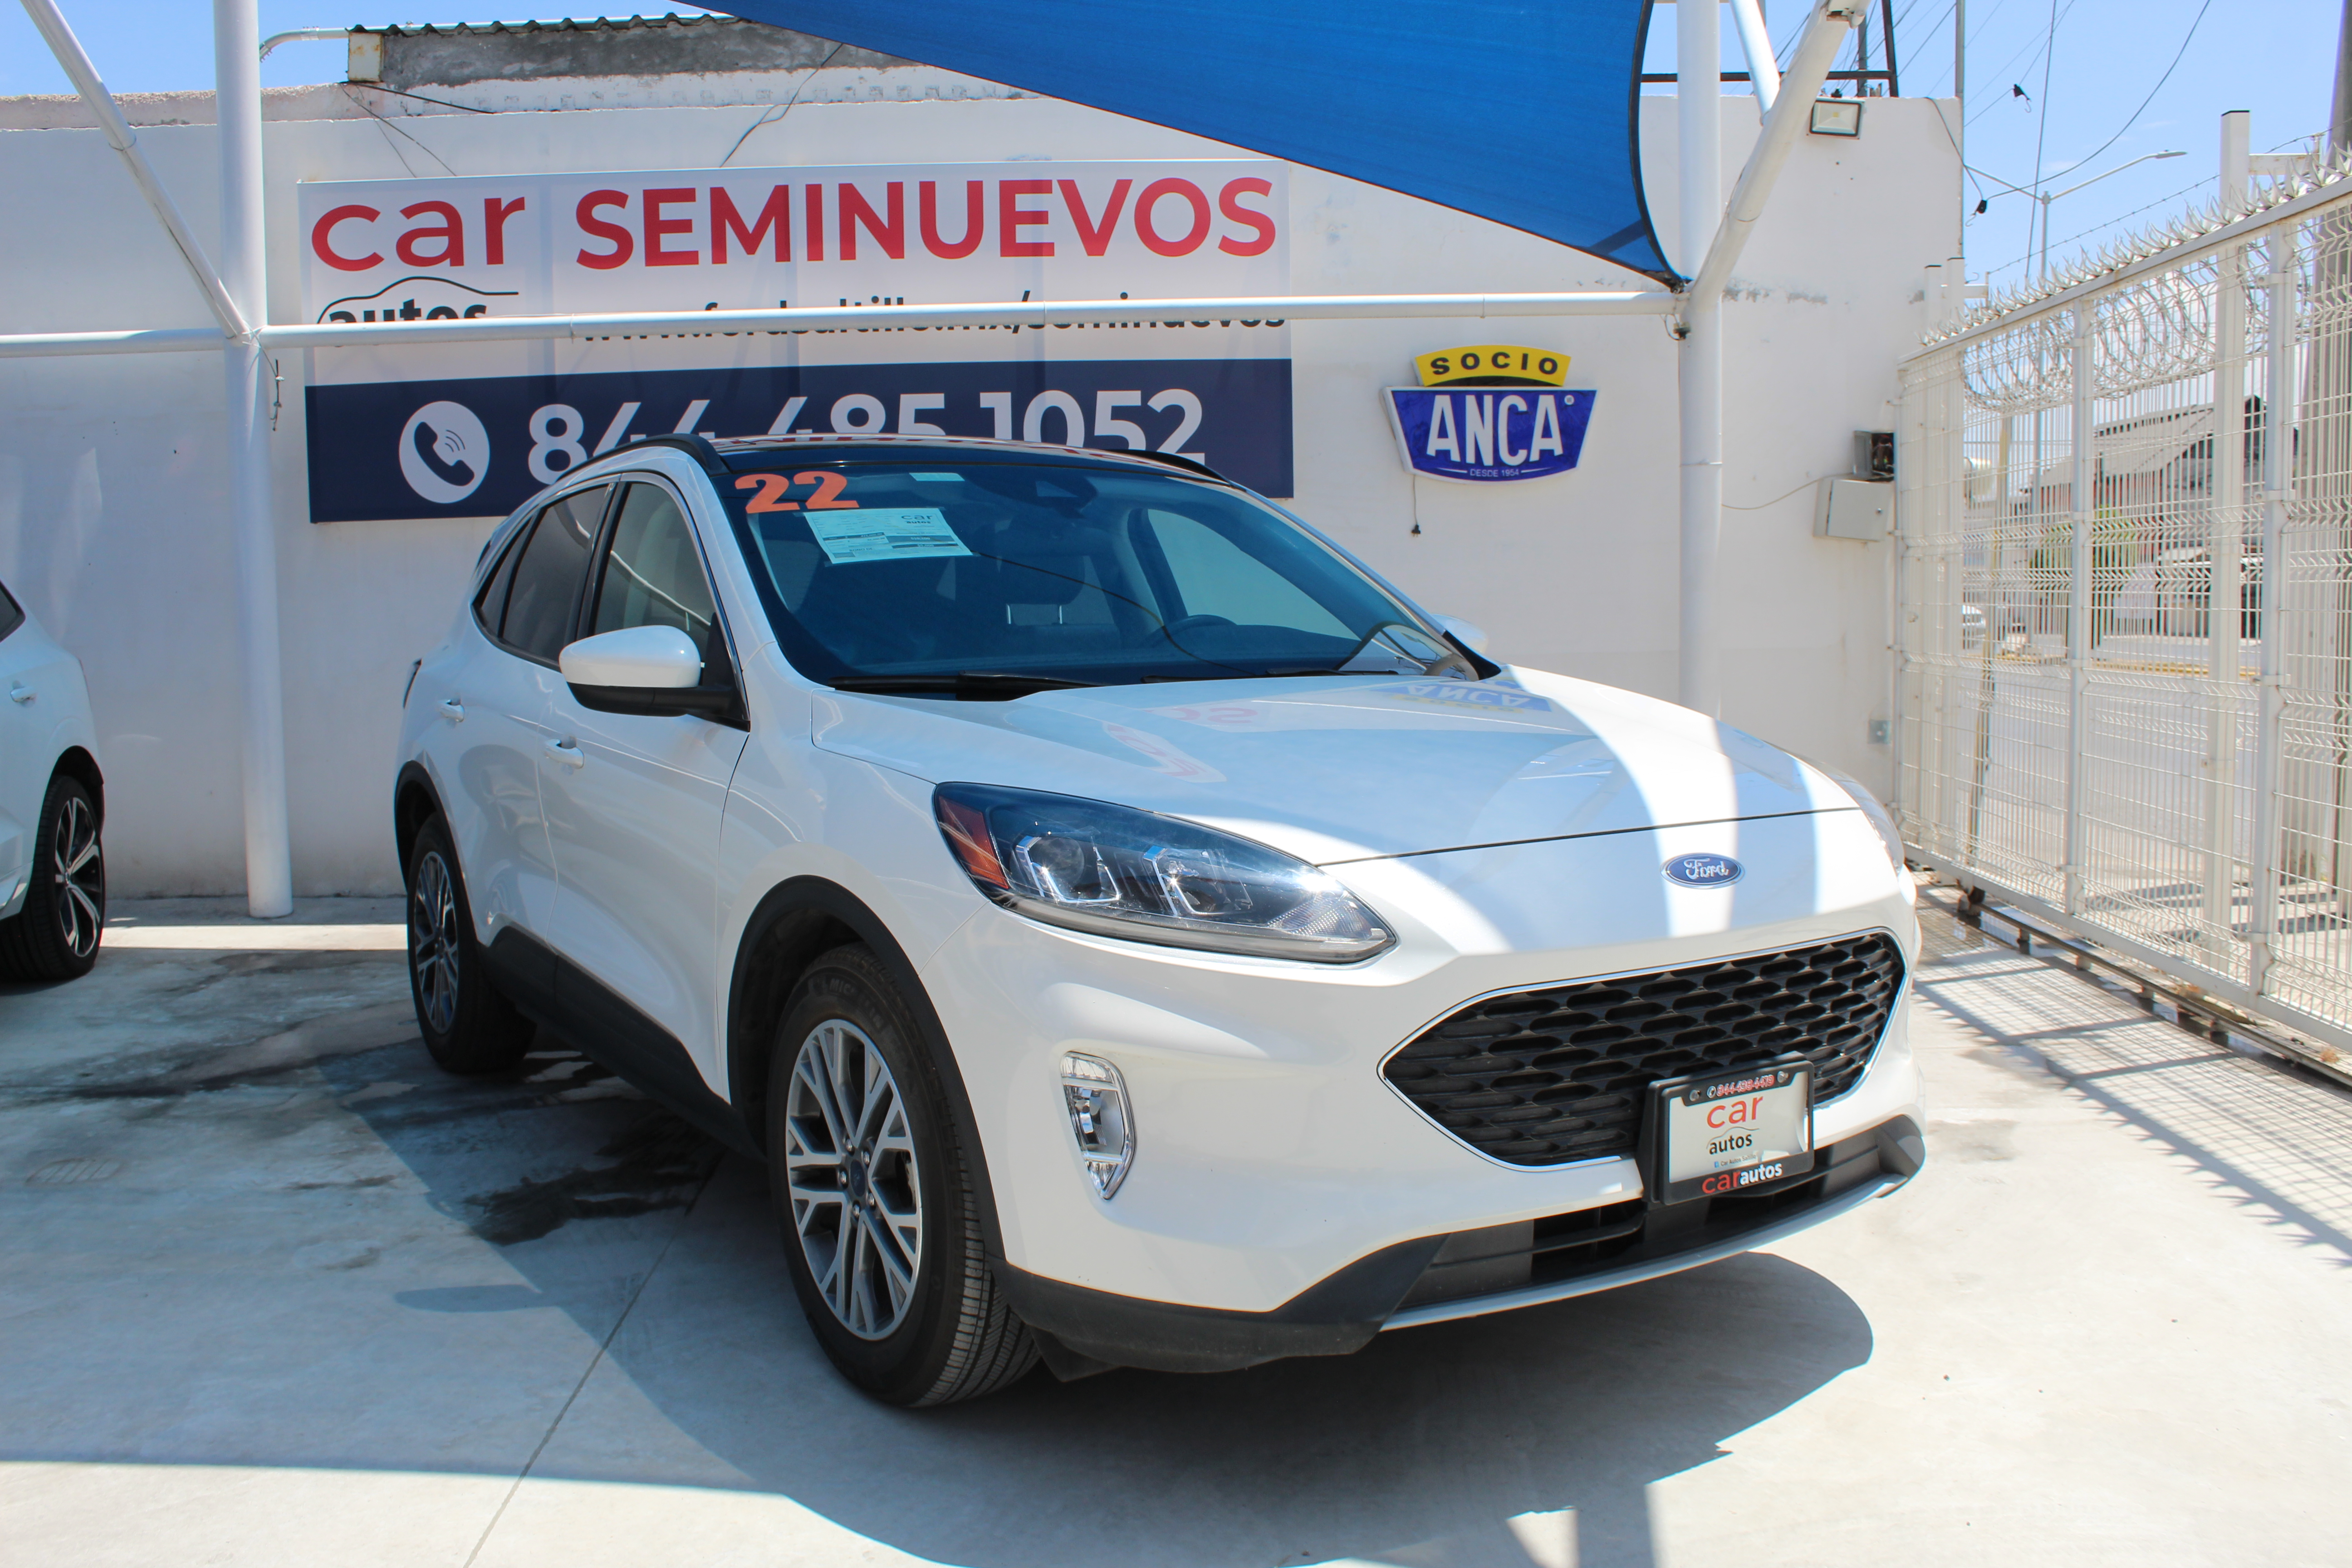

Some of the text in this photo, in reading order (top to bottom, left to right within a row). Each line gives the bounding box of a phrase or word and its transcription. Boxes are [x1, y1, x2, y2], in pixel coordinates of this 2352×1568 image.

[312, 176, 1276, 271] car SEMINUEVOS
[1431, 352, 1558, 375] SOCIO
[980, 388, 1205, 466] 1052
[1426, 394, 1563, 466] ANCA
[1470, 468, 1519, 477] DESDE 1954
[734, 470, 860, 514] 22
[1683, 858, 1730, 880] Ford
[1706, 1095, 1763, 1129] car
[1709, 1132, 1753, 1155] autos
